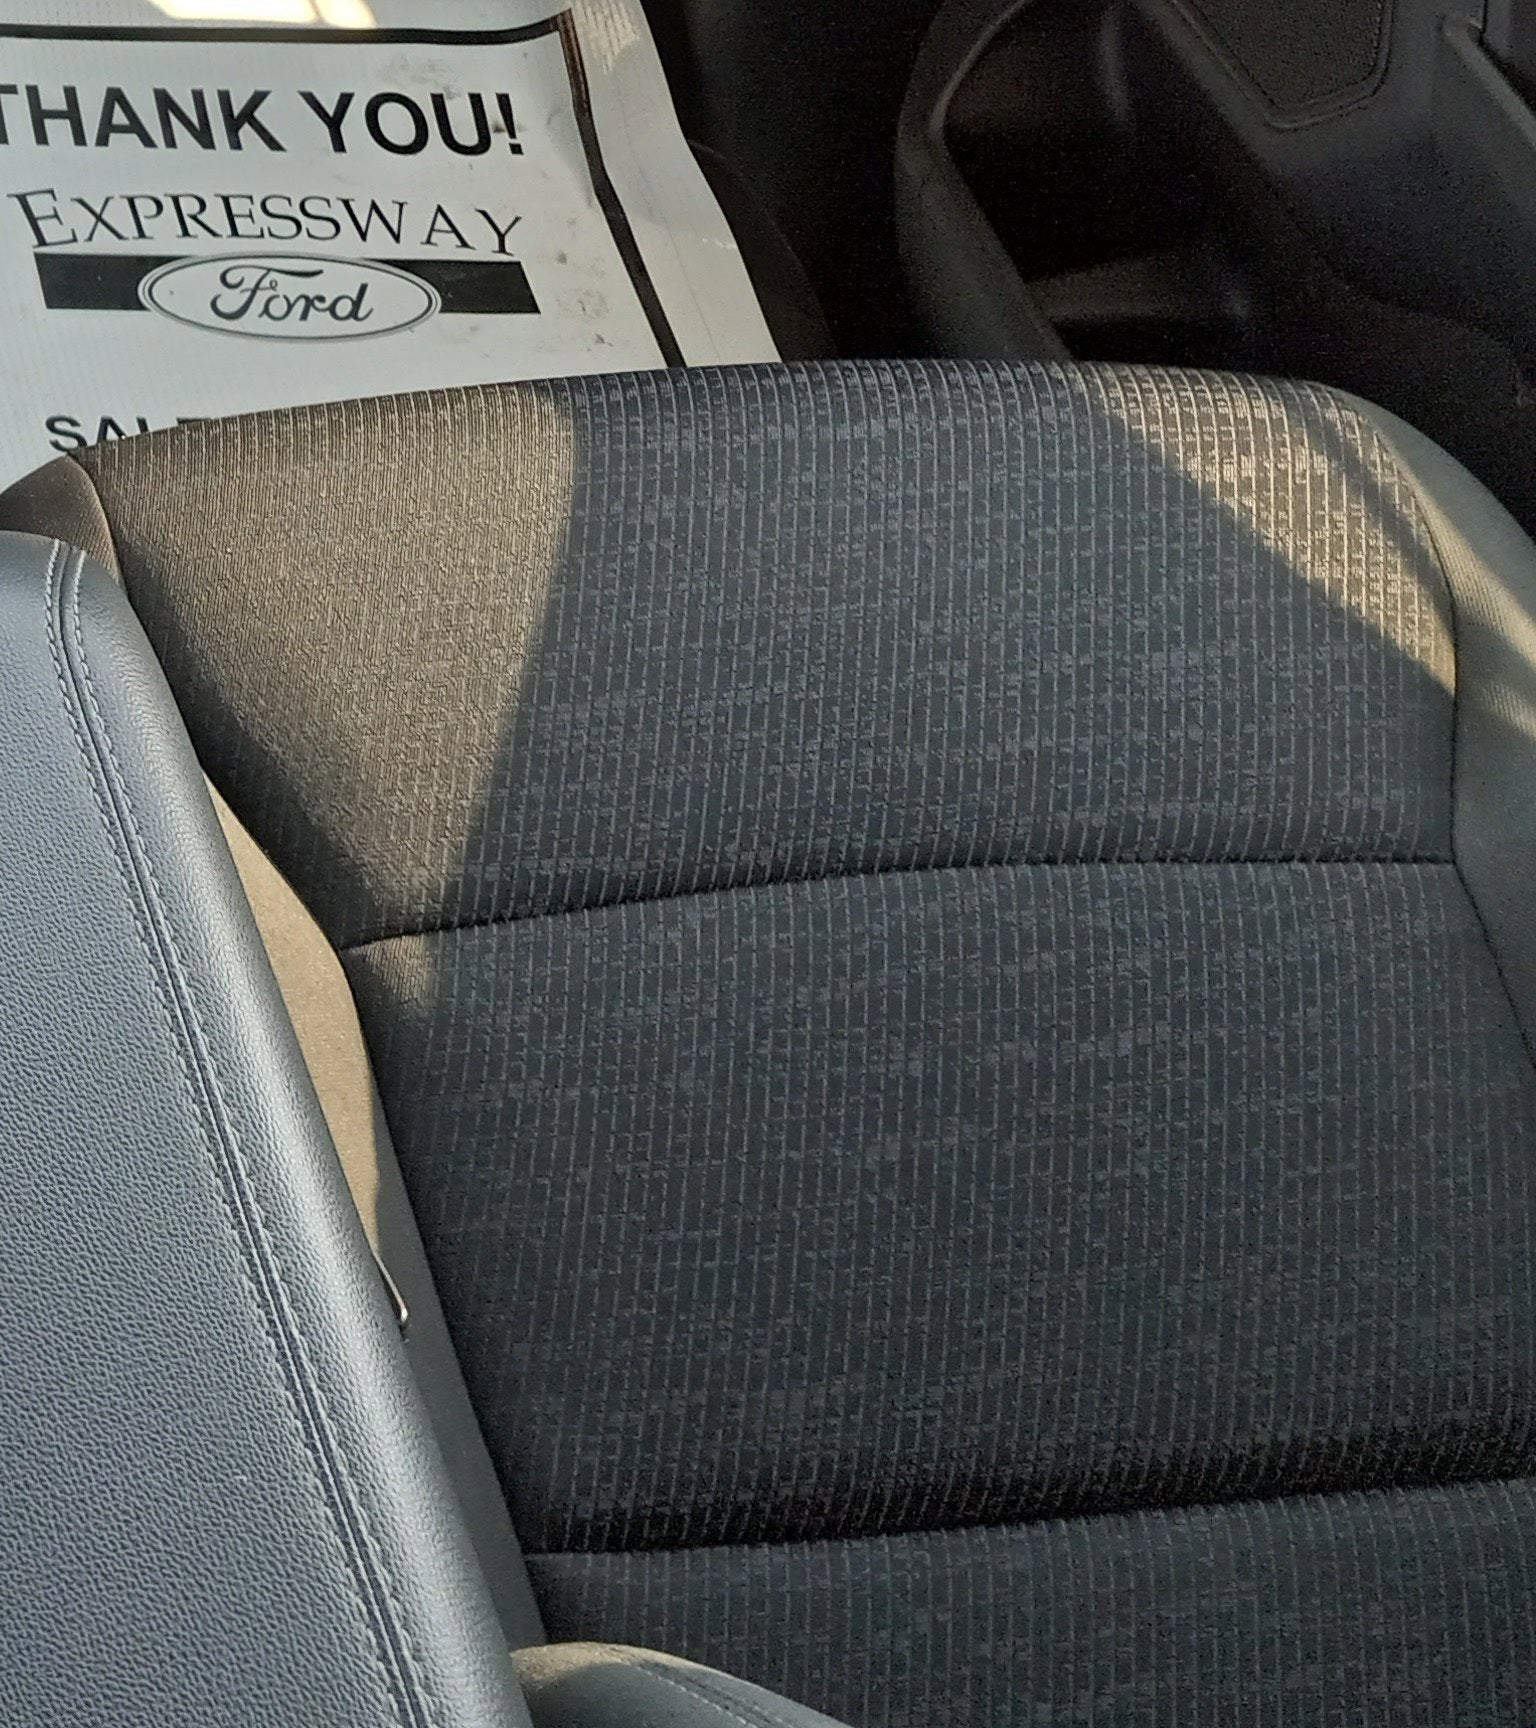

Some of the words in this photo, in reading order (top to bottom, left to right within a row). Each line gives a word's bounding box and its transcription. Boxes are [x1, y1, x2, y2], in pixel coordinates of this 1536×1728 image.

[297, 90, 525, 157] YOU!
[6, 186, 523, 257] EXPRESSWAY
[209, 263, 373, 325] Ford
